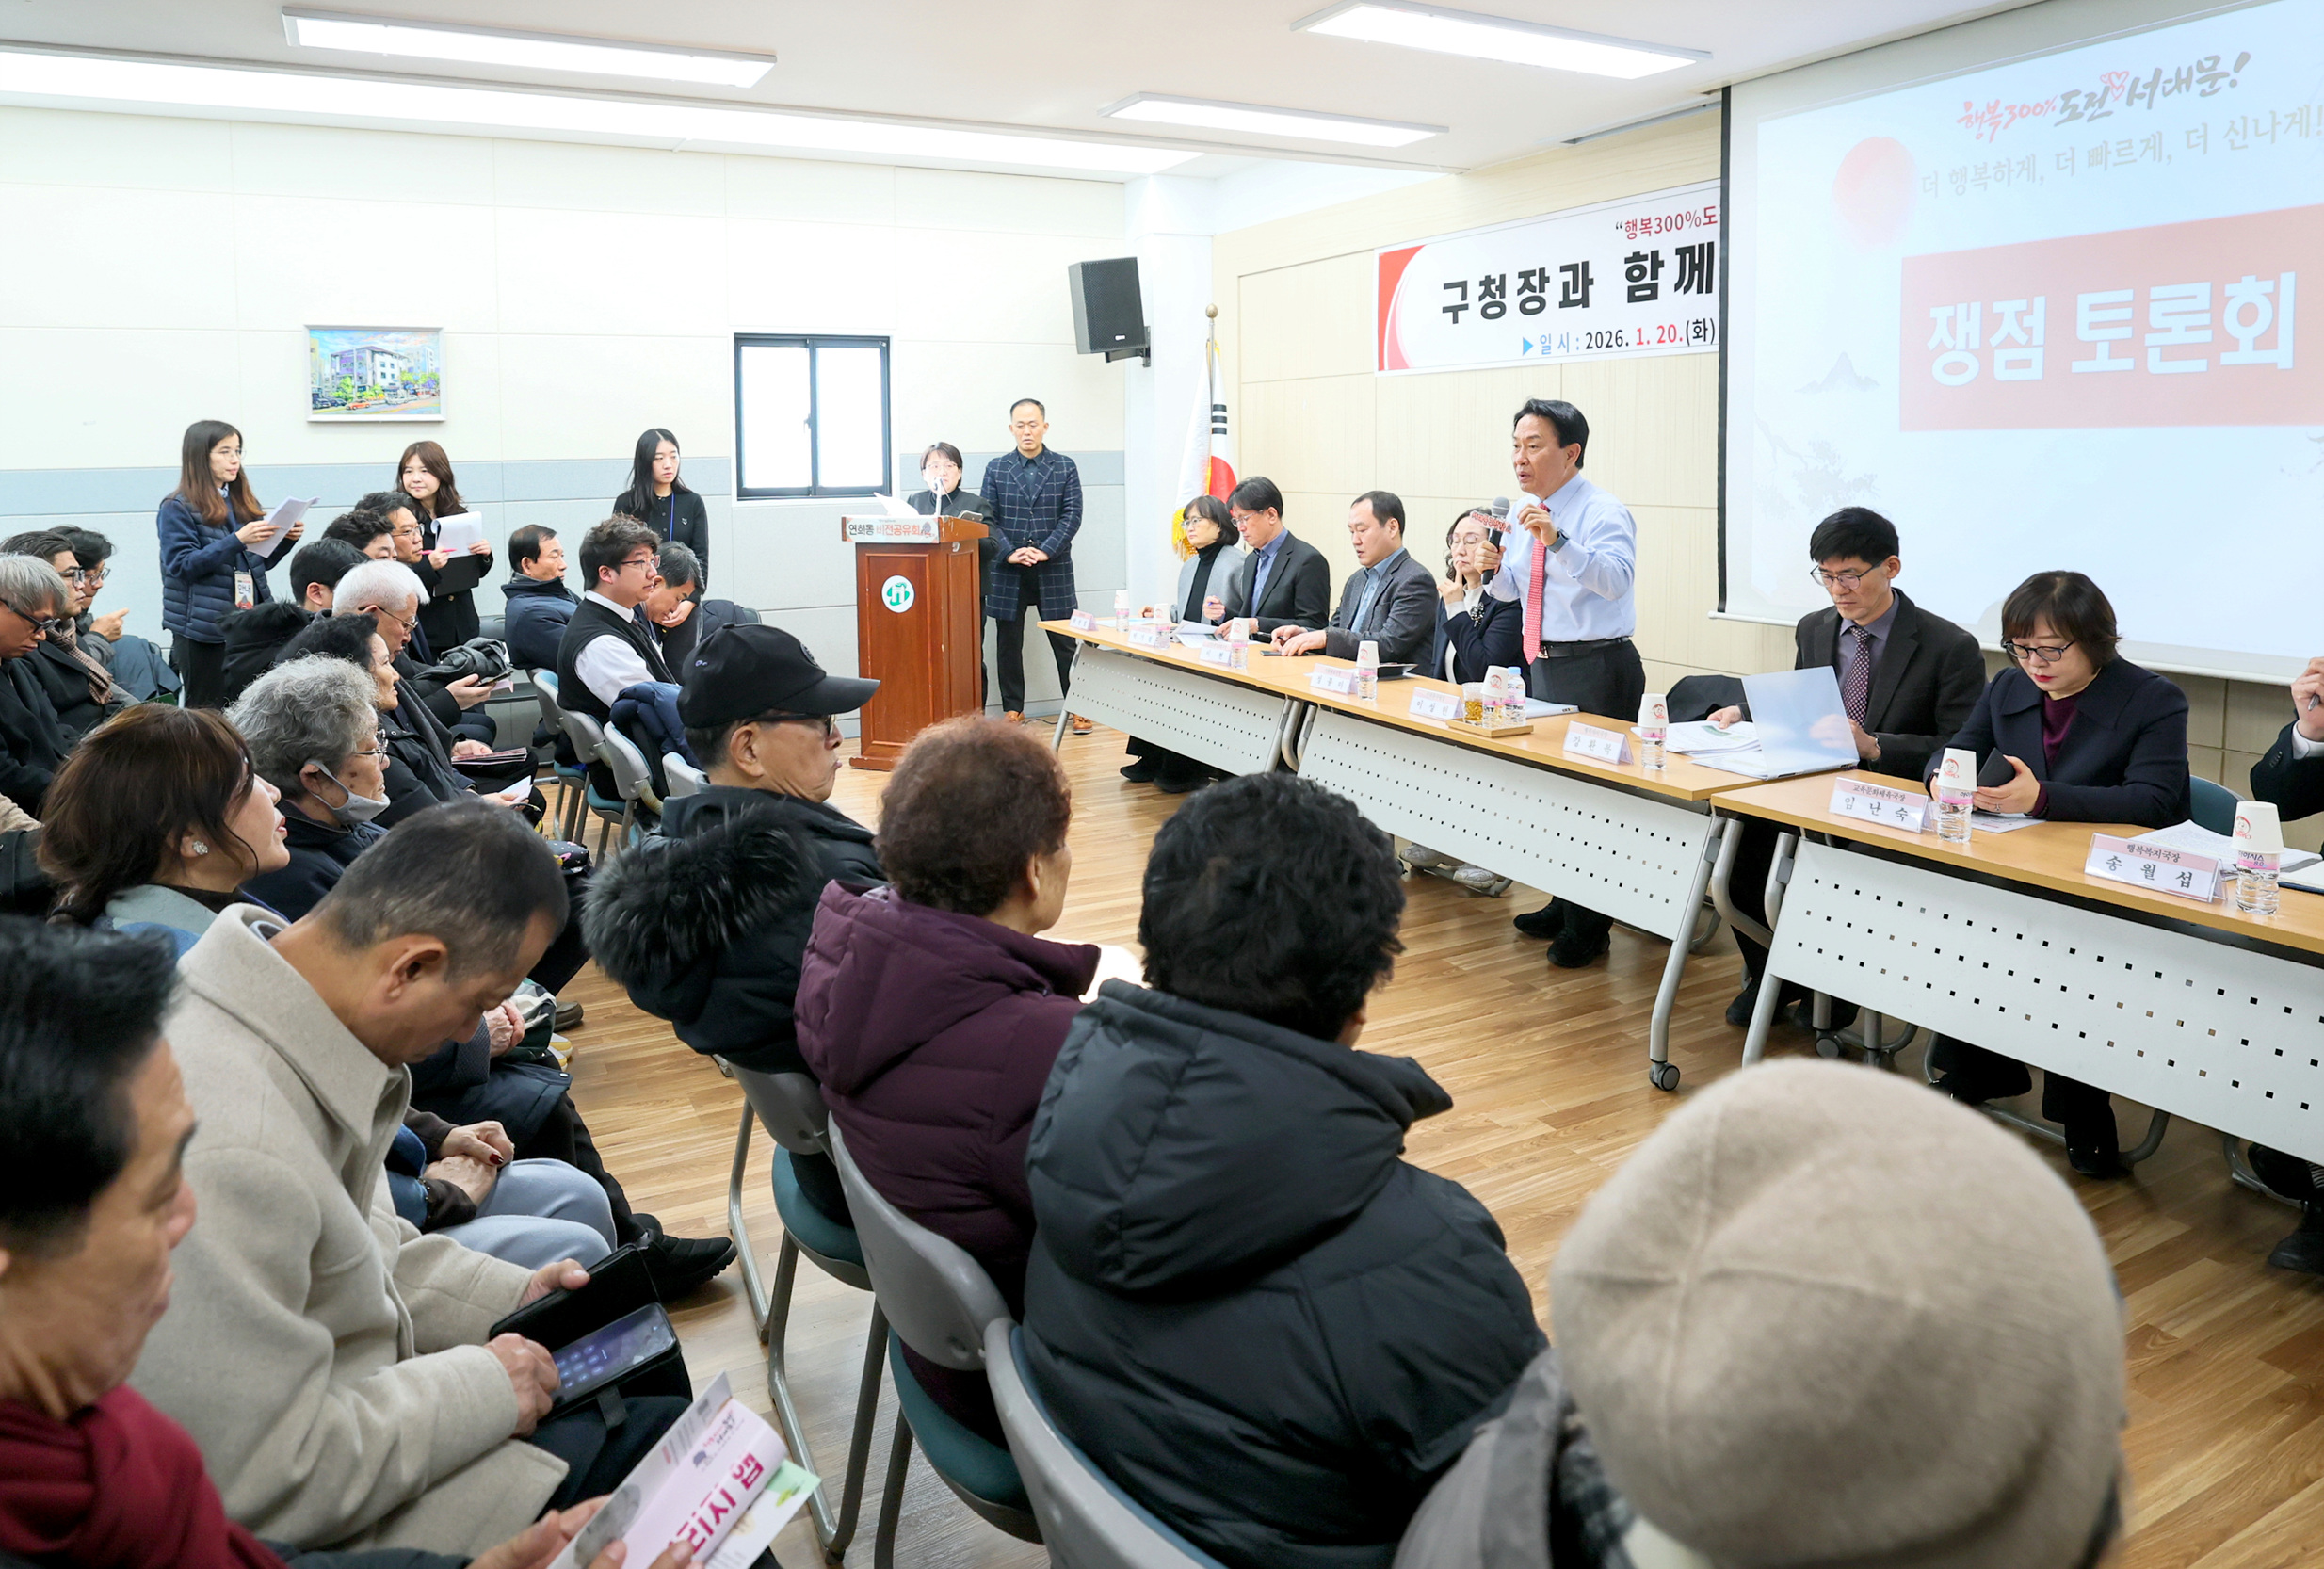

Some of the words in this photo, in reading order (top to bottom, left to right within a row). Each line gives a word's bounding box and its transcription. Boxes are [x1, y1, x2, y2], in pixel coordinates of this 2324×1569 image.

[2125, 51, 2251, 110] 서대문!
[1921, 170, 1940, 199] 더
[1947, 152, 2045, 197] 행복하게,
[2054, 145, 2076, 177] 더
[2087, 130, 2173, 171] 빠르게,
[2185, 121, 2208, 155] 더
[2222, 104, 2324, 151] 신나게!
[1615, 204, 1720, 241] “행복300%도
[1442, 260, 1594, 325] 구청장과
[1623, 240, 1716, 304] 함께
[1585, 330, 1630, 351] 2026.
[1926, 295, 2047, 388] 쟁점
[2071, 270, 2297, 376] 토론회
[848, 524, 874, 536] 연희동
[2126, 843, 2181, 864] 행복복지국장
[669, 1482, 737, 1555] 리지
